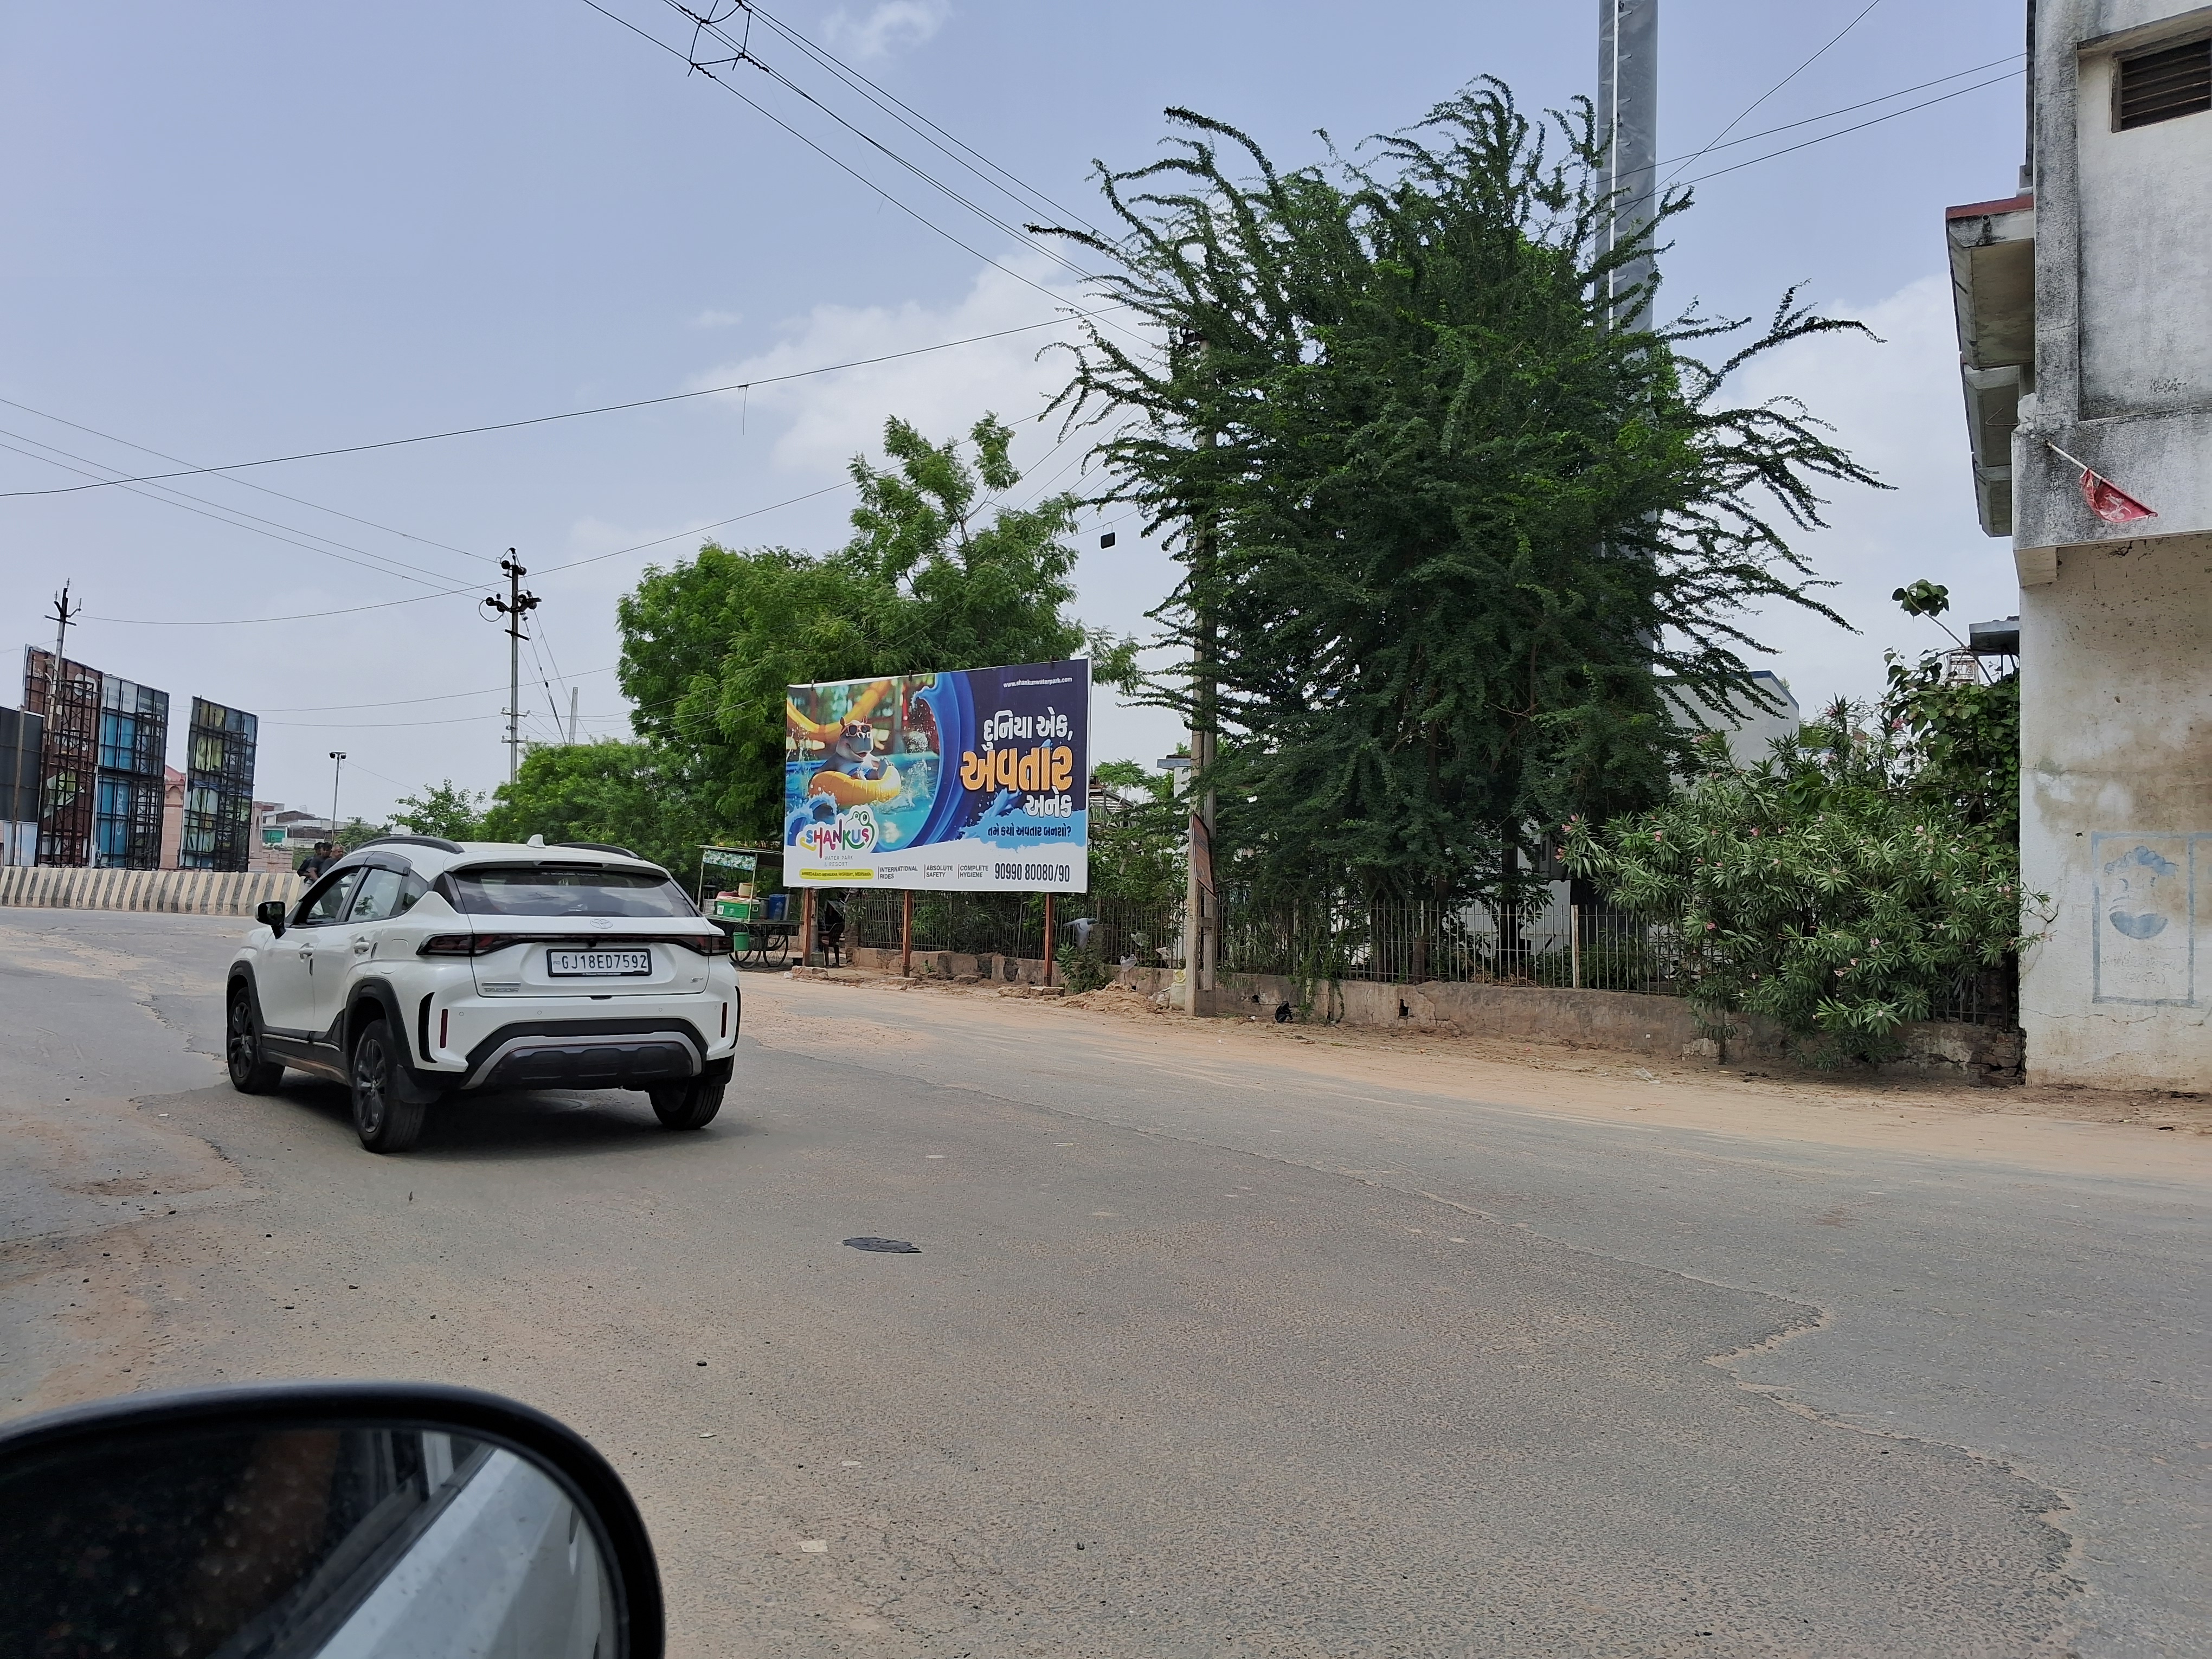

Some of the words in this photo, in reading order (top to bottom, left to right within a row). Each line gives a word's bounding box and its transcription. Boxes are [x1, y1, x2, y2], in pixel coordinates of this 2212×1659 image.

[1003, 677, 1072, 688] www.shankuswaterpark.com
[981, 710, 1032, 751] દુનિયા
[1036, 706, 1073, 741] એક,
[960, 746, 1073, 792] અવતાર
[1025, 786, 1072, 818] અનેક
[806, 819, 869, 859] SHANKUS
[987, 823, 999, 837] તમે
[1015, 826, 1042, 837] અવતાર
[995, 863, 1022, 880] 90990
[1025, 864, 1070, 883] 80080/90
[562, 954, 647, 969] GJ18ED7592
